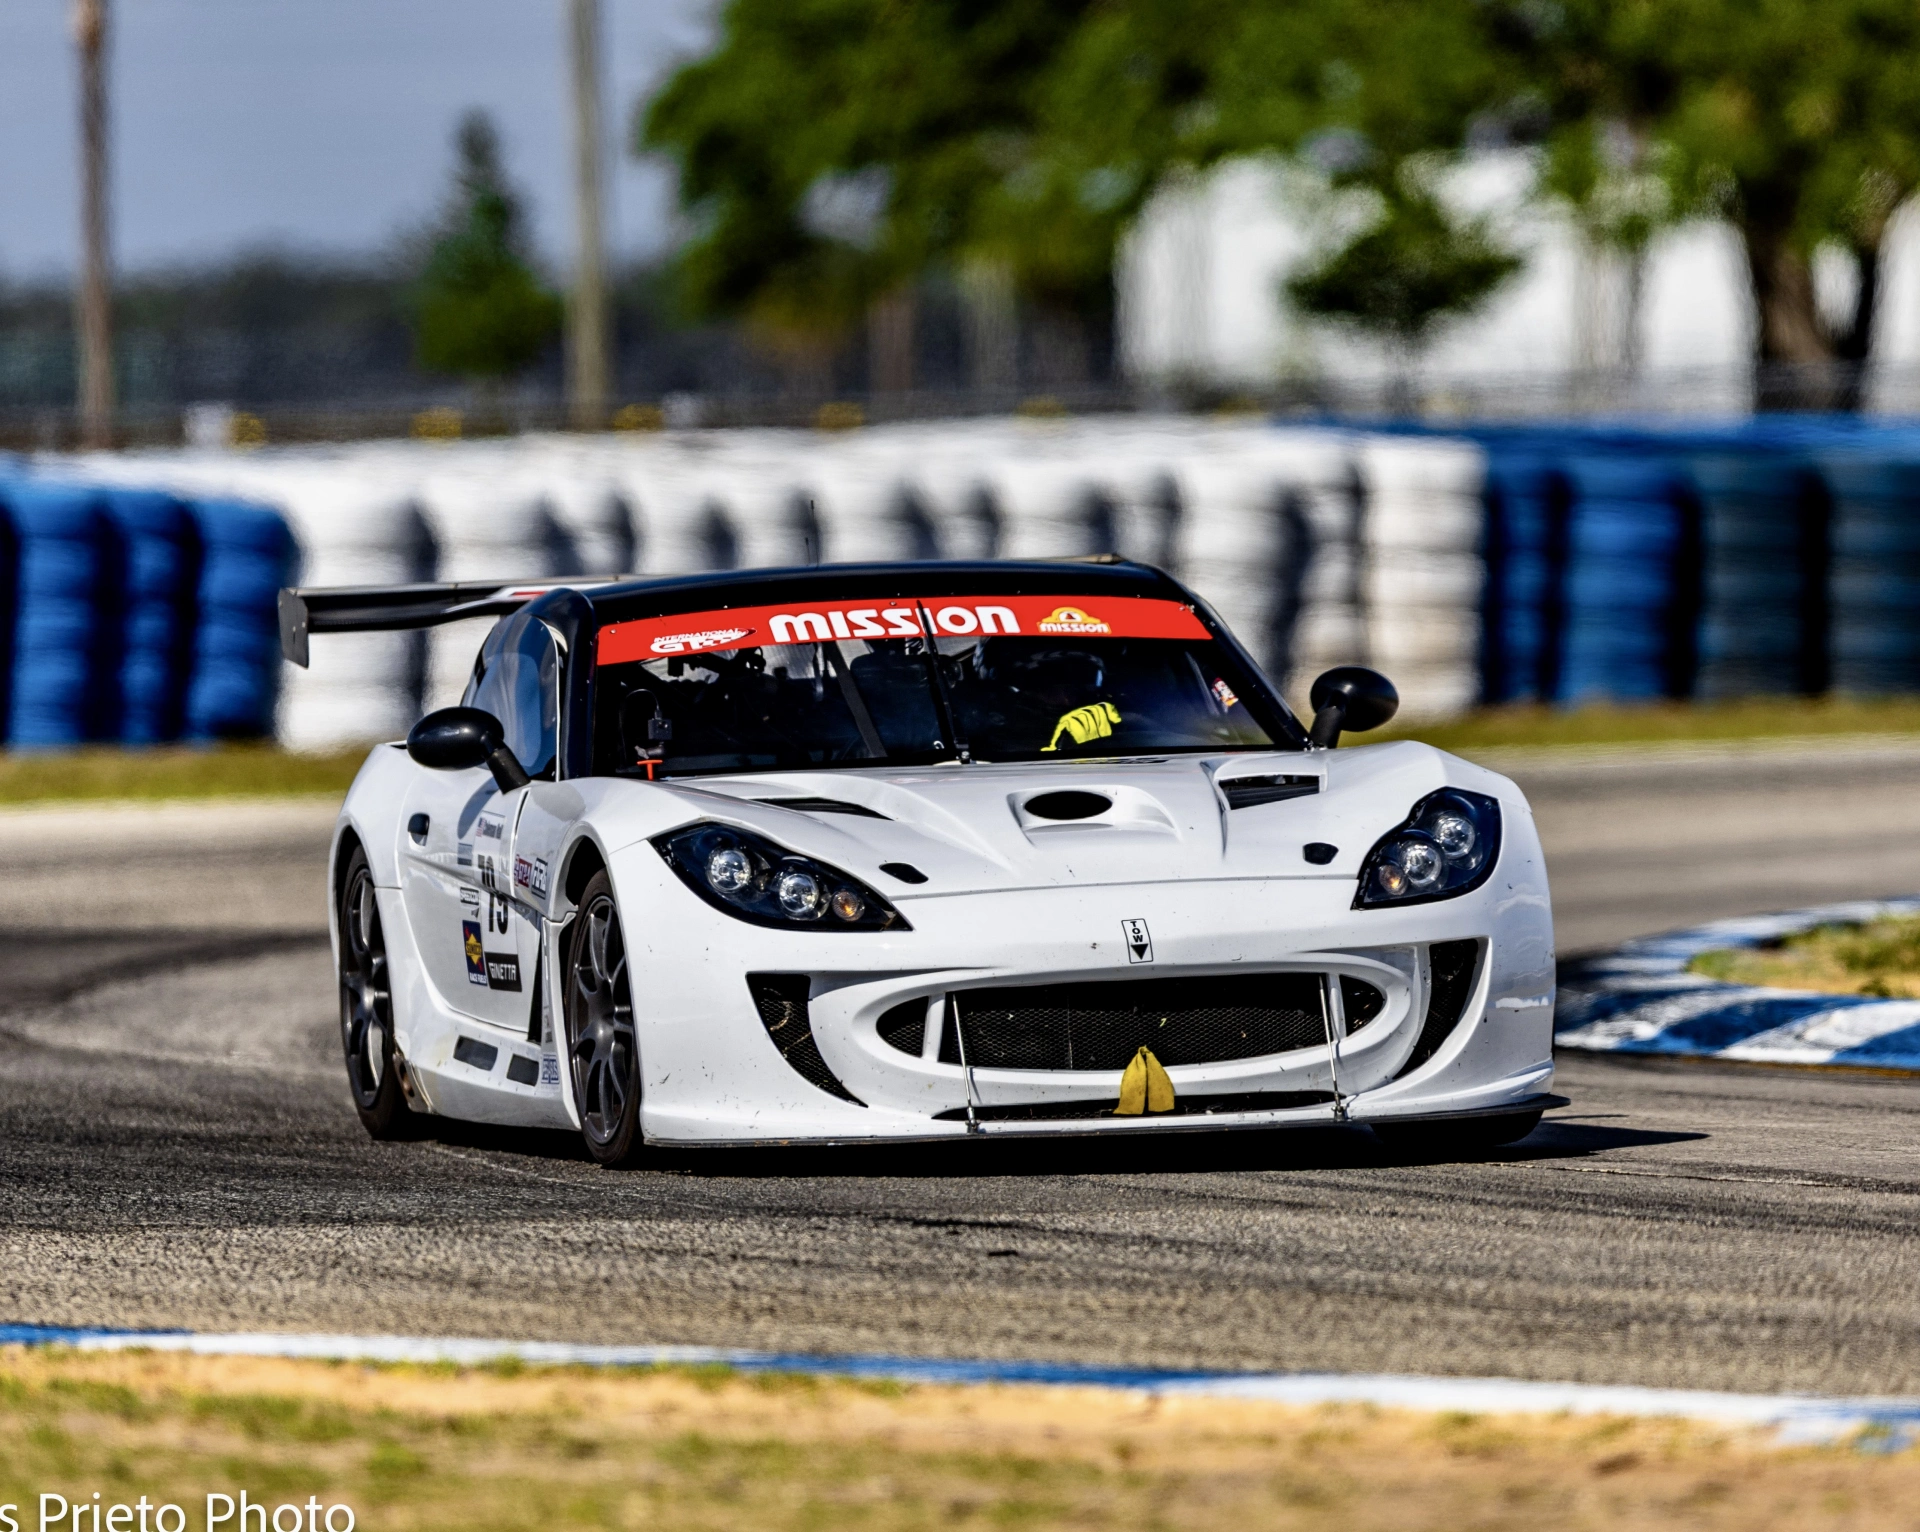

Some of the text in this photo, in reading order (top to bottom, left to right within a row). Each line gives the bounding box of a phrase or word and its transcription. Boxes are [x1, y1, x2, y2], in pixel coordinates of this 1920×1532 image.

[769, 606, 1021, 643] MISSION
[1040, 623, 1109, 633] MISSION
[653, 628, 740, 643] INTERNATIONAL
[1130, 921, 1143, 943] TOW
[488, 962, 517, 980] GINETTA
